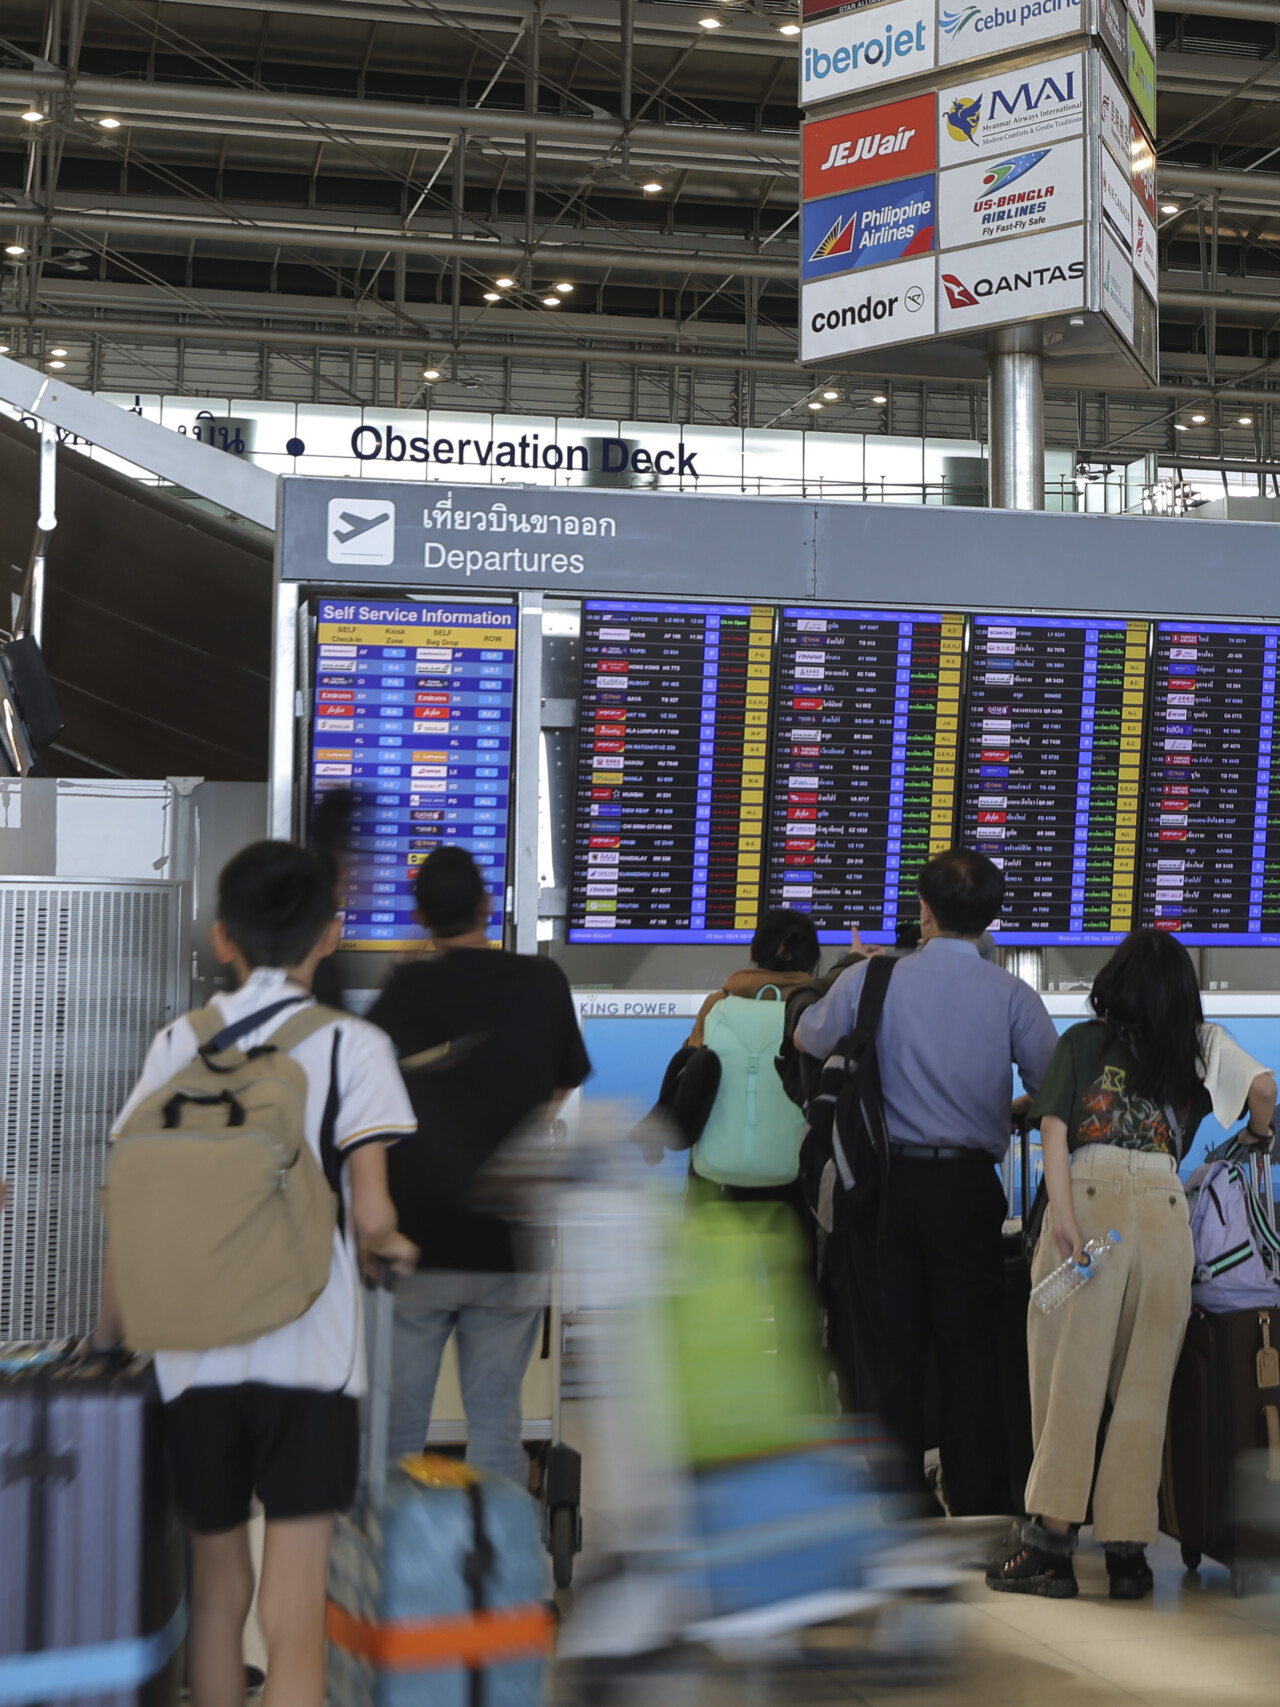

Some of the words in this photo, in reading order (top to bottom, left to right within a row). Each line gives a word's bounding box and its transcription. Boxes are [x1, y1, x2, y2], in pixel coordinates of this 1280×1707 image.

[974, 11, 1016, 33] cebu
[805, 20, 926, 82] iberojet
[988, 71, 1074, 120] MAI
[982, 120, 1012, 132] Myanmar
[1013, 112, 1038, 124] Airways
[1040, 101, 1082, 118] International
[982, 134, 1004, 146] Modern
[1003, 128, 1029, 140] Comforts
[1035, 122, 1054, 133] Gentle
[1054, 116, 1083, 127] Traditions
[820, 126, 916, 170] JEJUair
[861, 200, 931, 230] Philippine
[982, 201, 1047, 224] AIRLINES
[982, 226, 995, 237] Fly
[996, 219, 1026, 233] Fast-Fly
[1028, 216, 1046, 226] Safe
[859, 224, 915, 249] Airlines
[974, 261, 1084, 298] QANTAS
[811, 295, 899, 333] condor
[351, 425, 589, 472] Observation
[601, 438, 699, 477] Deck
[422, 491, 617, 538] เที่ยวบินขาออก
[423, 542, 585, 577] Departures
[323, 605, 354, 620] Self
[359, 607, 418, 622] Service
[422, 609, 512, 625] Information
[386, 637, 404, 645] Zone
[441, 639, 460, 647] Drop
[321, 692, 352, 700] Emirates
[580, 1001, 619, 1015] KING
[623, 1001, 677, 1015] POWER
